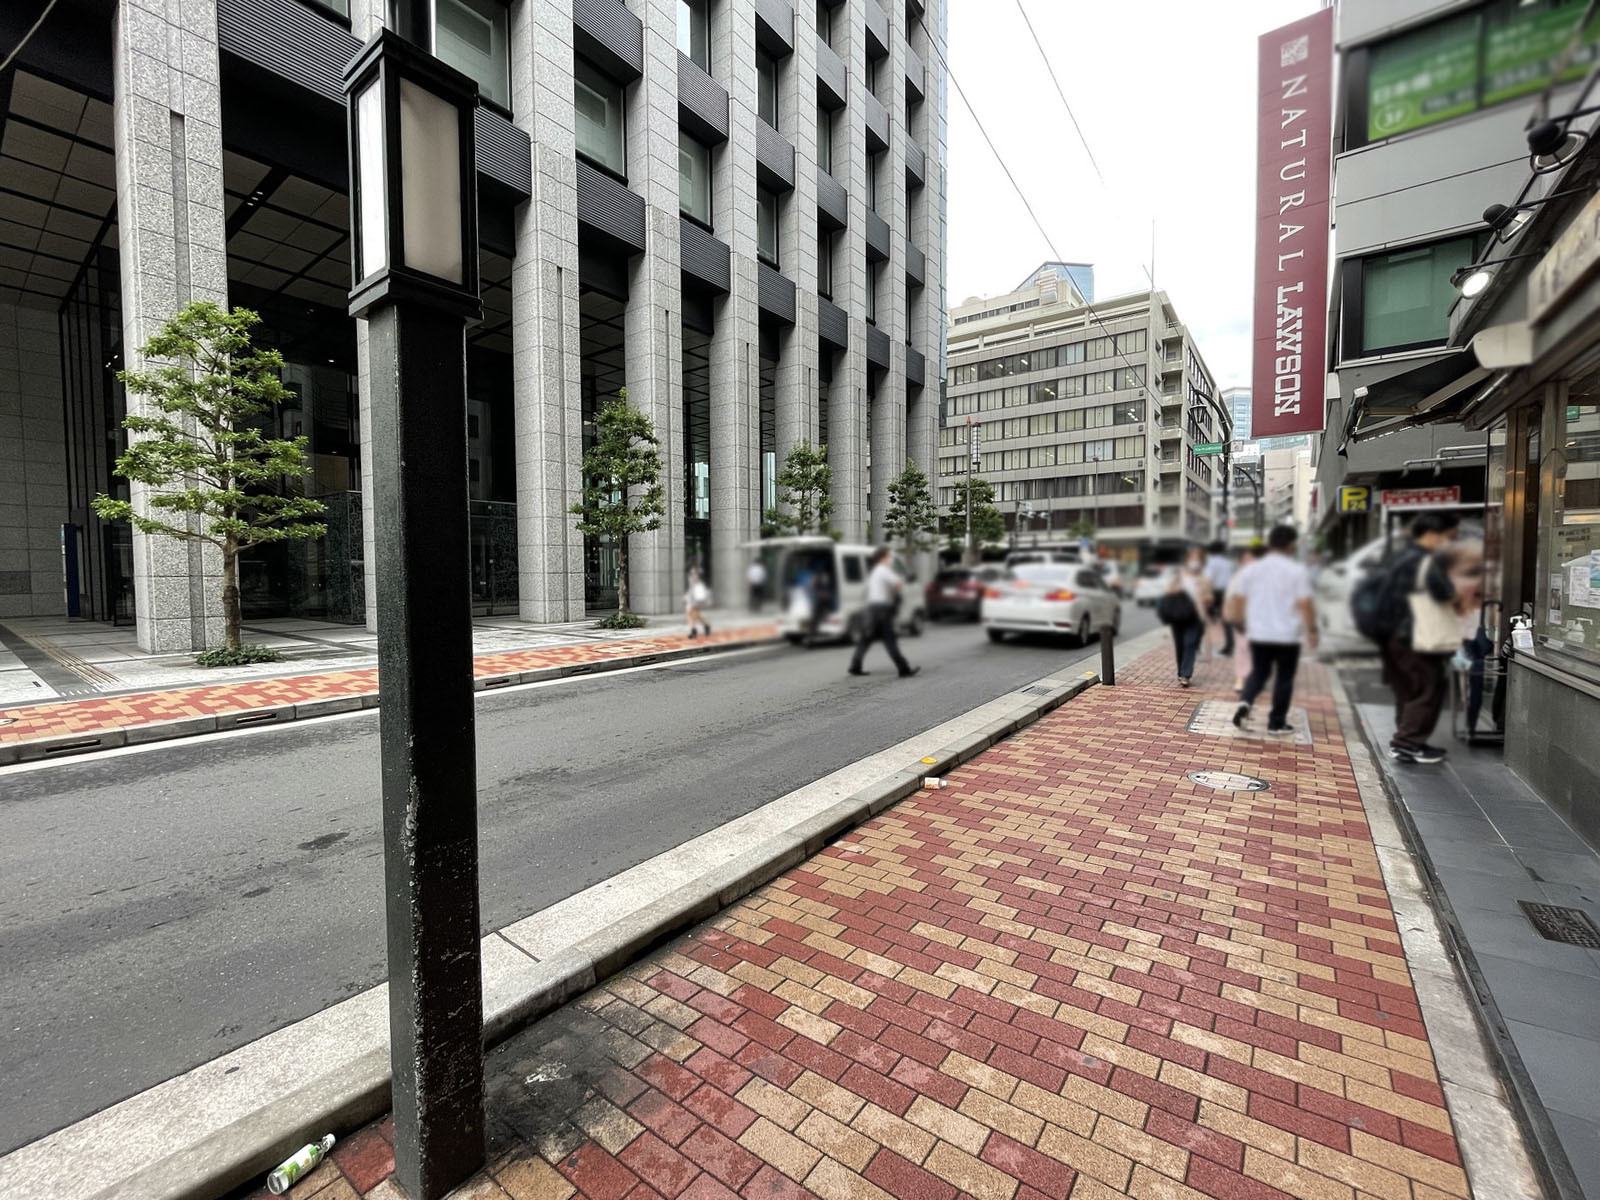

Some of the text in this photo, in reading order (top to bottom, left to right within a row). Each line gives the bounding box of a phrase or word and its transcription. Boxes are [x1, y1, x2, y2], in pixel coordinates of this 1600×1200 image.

[1275, 74, 1307, 417] NATURAL LAWSON
[1341, 487, 1369, 511] P
